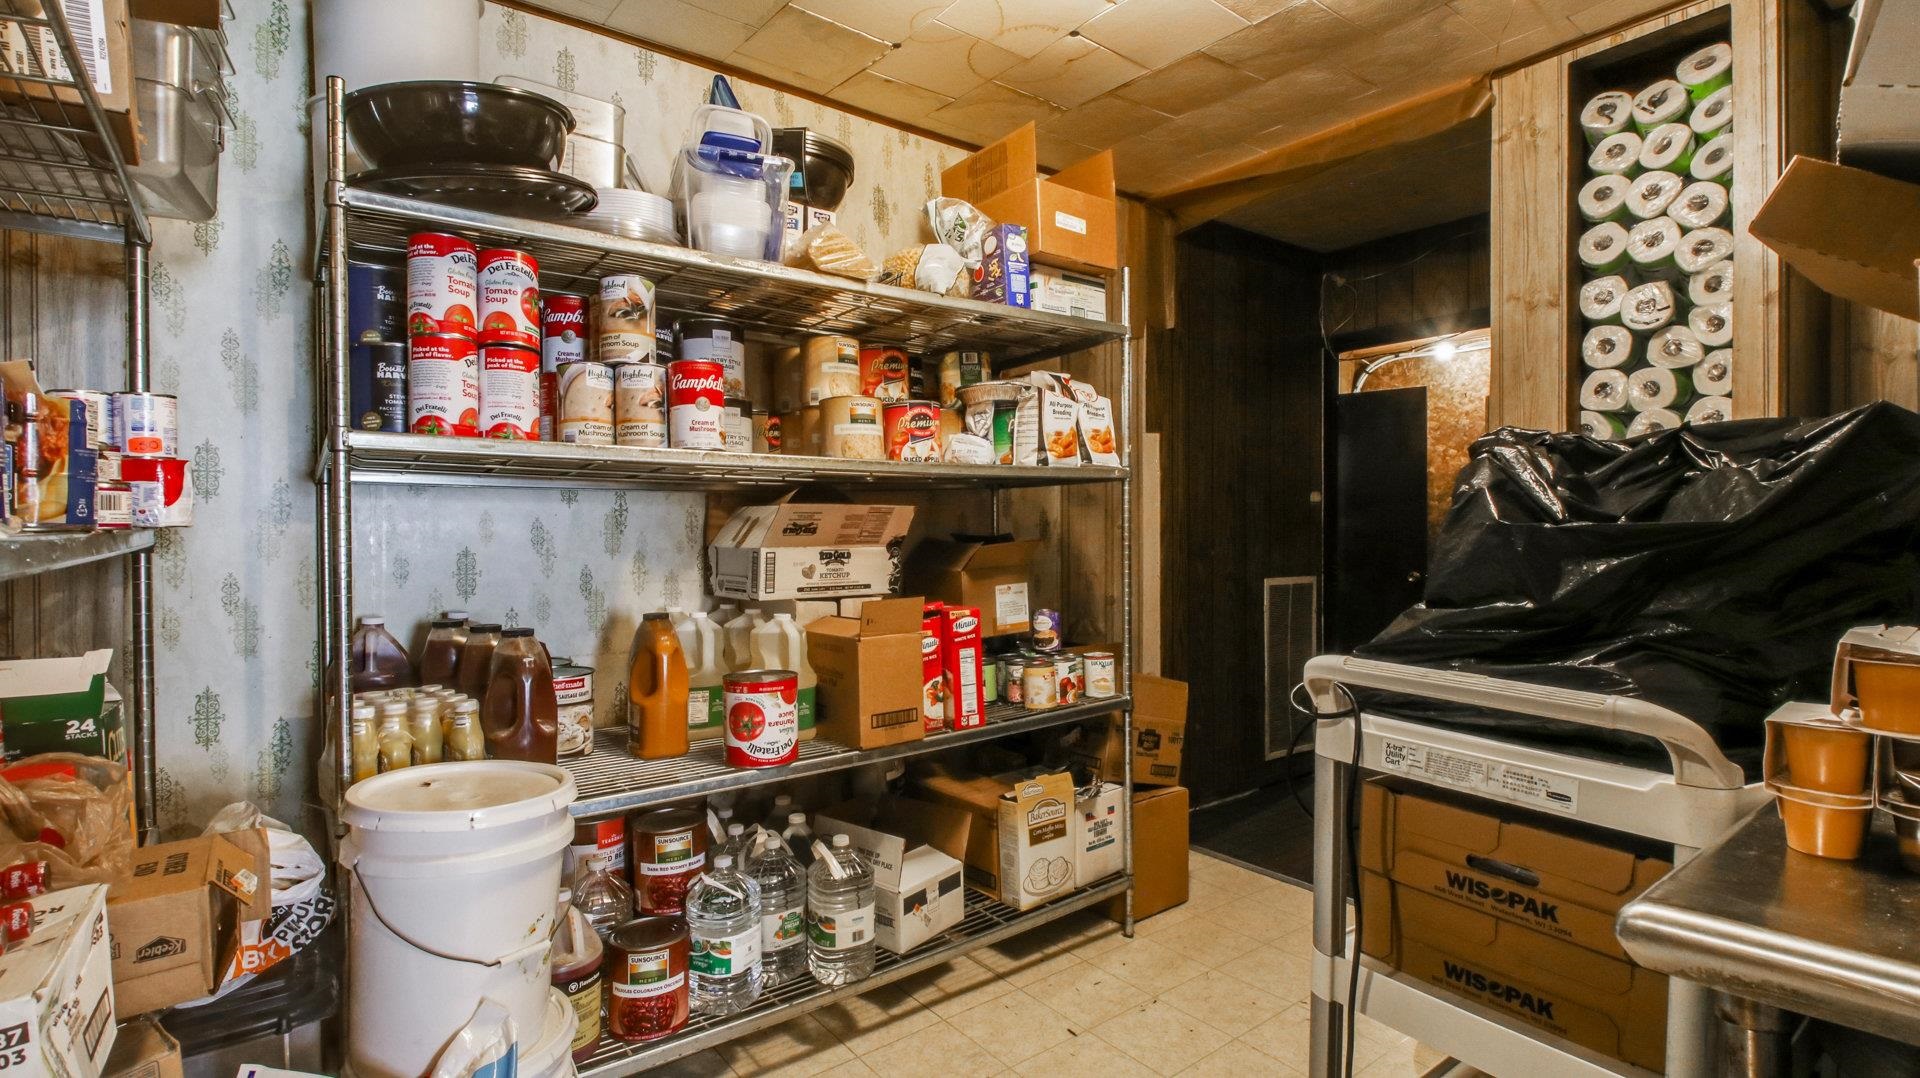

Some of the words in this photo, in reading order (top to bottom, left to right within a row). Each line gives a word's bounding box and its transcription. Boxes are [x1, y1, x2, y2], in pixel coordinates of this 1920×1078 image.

[451, 253, 466, 264] Dei
[488, 263, 504, 275] Dei
[505, 262, 535, 281] Fratelli
[448, 285, 470, 298] Soup
[485, 287, 518, 295] Tomato
[485, 296, 508, 304] Soup
[622, 370, 653, 379] Highland
[672, 374, 724, 392] Campbell
[415, 405, 425, 413] Dei
[778, 710, 794, 718] Sauce
[66, 718, 96, 734] 24
[768, 718, 795, 727] Marinara
[64, 731, 98, 741] STACKS
[747, 742, 781, 755] Fratelli
[780, 737, 793, 751] Dei
[1385, 749, 1406, 761] Utility
[1385, 757, 1401, 766] Cart
[657, 835, 689, 845] SUNSOURCE
[881, 861, 893, 870] PLACE
[140, 939, 184, 959] Keebler
[631, 953, 666, 963] SUNSOURCE
